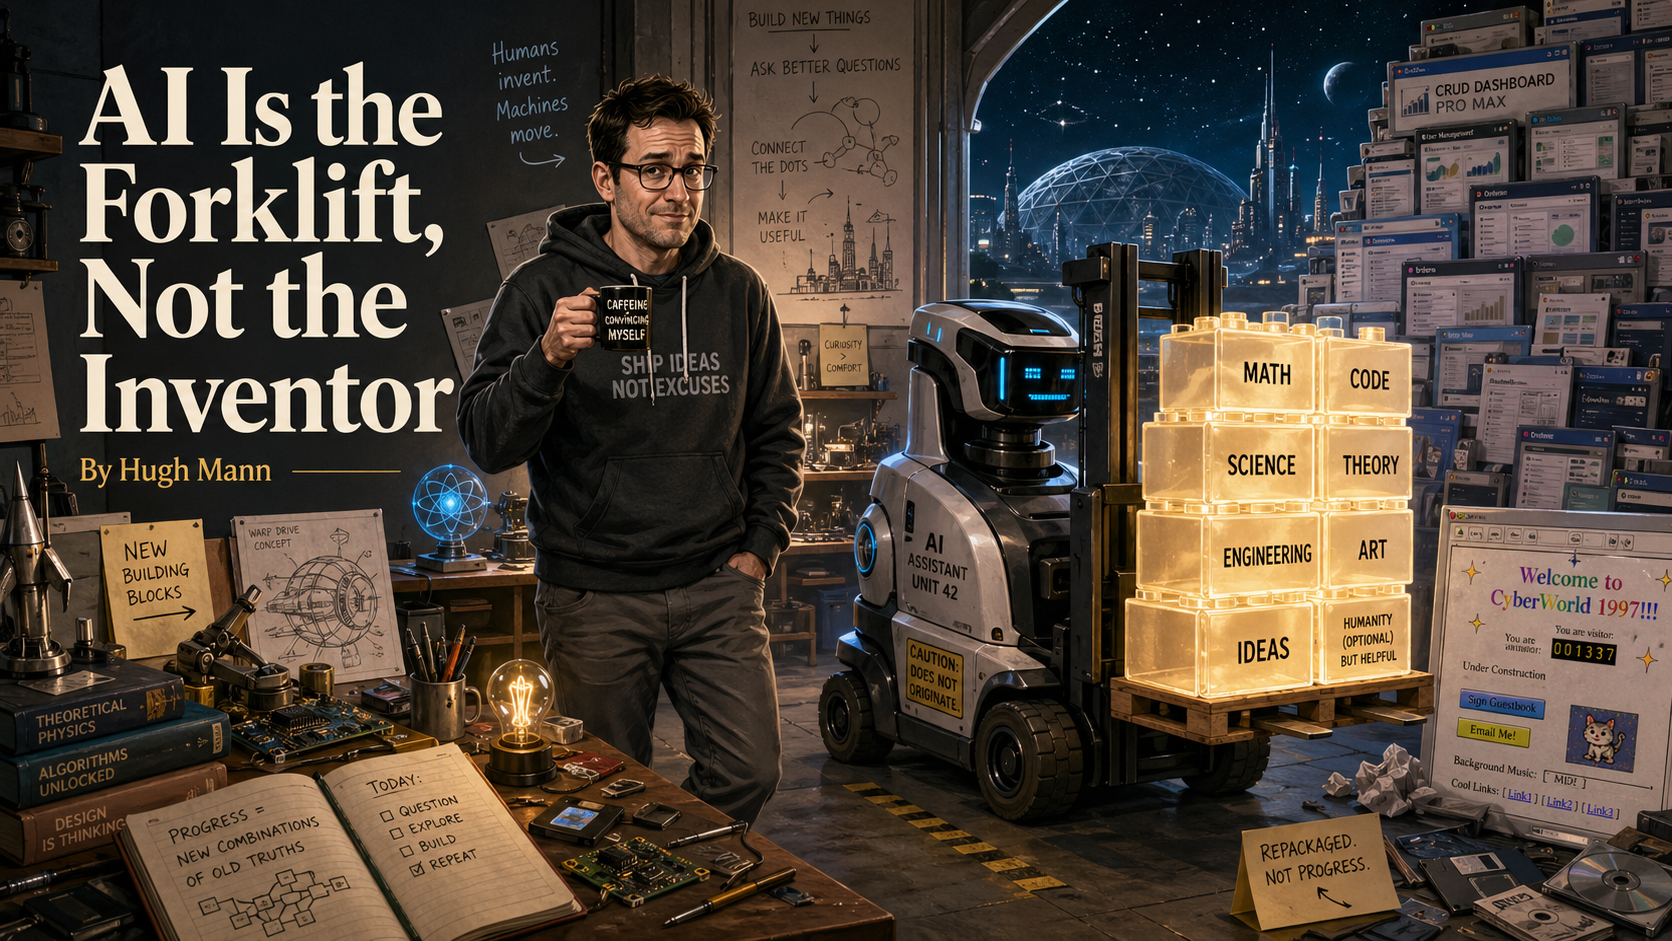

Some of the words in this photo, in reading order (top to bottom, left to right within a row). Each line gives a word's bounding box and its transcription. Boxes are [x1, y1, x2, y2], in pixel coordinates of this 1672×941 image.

[748, 12, 786, 28] BUILD
[792, 11, 820, 26] NEW
[826, 10, 871, 25] THINGS
[492, 40, 559, 65] Humans
[498, 65, 556, 90] invent.
[751, 61, 776, 77] ASK
[783, 59, 831, 75] BETTER
[836, 58, 901, 74] QUESTIONS
[1435, 81, 1470, 97] CRUD
[1474, 72, 1555, 93] DASHBOARD
[497, 96, 568, 121] Machines
[1435, 99, 1467, 115] PRO
[1472, 95, 1506, 111] MAX
[511, 125, 559, 144] move.
[751, 140, 806, 155] CONNECT
[752, 161, 778, 174] THE
[780, 159, 808, 173] DOTS
[758, 211, 791, 225] MAKE
[797, 210, 808, 223] IT
[760, 229, 806, 244] USEFUL
[606, 299, 648, 310] CAFFEINE
[608, 328, 645, 341] MYSELF
[824, 339, 862, 350] CURIOSITY
[669, 352, 720, 373] IDEAS
[826, 363, 862, 373] COMFORT
[1243, 361, 1291, 385] MATH
[612, 378, 648, 399] NOT
[655, 375, 730, 397] EXCUSES
[1350, 368, 1390, 390] CODE
[1227, 454, 1296, 476] SCIENCE
[1342, 454, 1400, 475] THEORY
[248, 526, 272, 538] WARP
[276, 525, 300, 536] DRIVE
[124, 540, 168, 561] NEW
[254, 538, 292, 550] CONCEPT
[925, 532, 944, 554] AI
[1358, 539, 1388, 561] ART
[1223, 543, 1312, 568] ENGINEERING
[122, 562, 190, 584] BUILDING
[907, 553, 968, 581] ASSISTANT
[912, 574, 940, 595] UNIT
[942, 583, 958, 601] 42
[1520, 566, 1598, 589] Welcome
[1604, 574, 1623, 591] to
[126, 585, 182, 606] BLOCKS
[1491, 589, 1592, 614] CyberWorld
[1597, 597, 1658, 621] 1997!!!
[1343, 613, 1393, 630] HUMANITY
[1555, 625, 1571, 635] You
[1572, 629, 1586, 637] are
[1587, 628, 1614, 640] visitor:
[1342, 630, 1394, 650] (OPTIONAL)
[1505, 633, 1520, 644] You
[1522, 637, 1536, 645] are
[910, 644, 959, 673] CAUTION:
[1237, 636, 1289, 665] IDEAS
[1341, 654, 1359, 668] BUT
[1360, 649, 1397, 665] HELPFUL
[1553, 642, 1615, 661] 001337
[910, 664, 935, 684] DOES
[937, 673, 958, 692] NOT
[1462, 660, 1490, 674] Under
[1491, 663, 1546, 681] Construction
[909, 683, 961, 713] ORIGINATE.
[1468, 695, 1487, 708] Sign
[1489, 698, 1537, 713] Guestbook
[36, 698, 127, 729] THEORETICAL
[38, 720, 96, 745] PHYSICS
[1469, 724, 1496, 738] Email
[1498, 729, 1517, 741] Me!
[38, 748, 128, 781] ALGORITHMS
[1453, 755, 1505, 775] Background
[1507, 765, 1538, 780] Music:
[39, 768, 115, 797] UNLOCKED
[366, 774, 423, 796] TODAY:
[1451, 778, 1472, 791] Cool
[1473, 782, 1499, 796] Links:
[399, 795, 459, 818] QUESTION
[55, 806, 107, 832] DESIGN
[168, 809, 249, 844] PROGRESS
[408, 812, 464, 836] EXPLORE
[42, 837, 55, 852] IS
[59, 818, 126, 847] THINKING
[176, 846, 211, 868] NEW
[217, 815, 320, 853] COMBINATIONS
[418, 834, 457, 853] BUILD
[1259, 833, 1357, 862] REPACKAGED.
[186, 872, 205, 888] OF
[211, 860, 241, 880] OLD
[246, 841, 305, 868] TRUTHS
[429, 848, 478, 871] REPEAT
[1265, 867, 1293, 886] NOT
[1296, 856, 1371, 882] PROGRESS.
